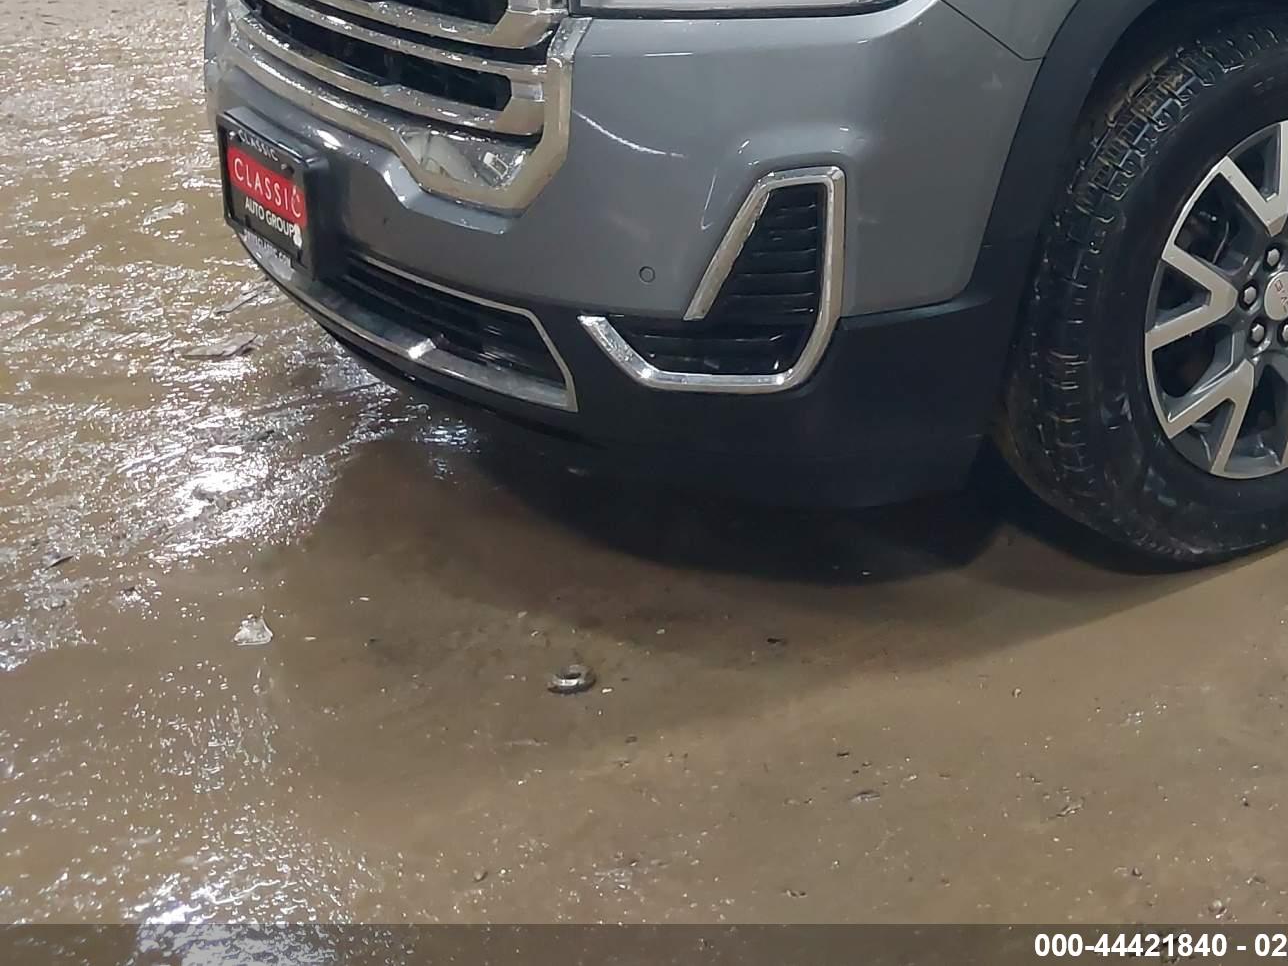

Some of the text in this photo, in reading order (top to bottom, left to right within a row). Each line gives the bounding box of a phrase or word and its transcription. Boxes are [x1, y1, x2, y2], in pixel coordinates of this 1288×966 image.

[238, 129, 279, 162] CLASSIC
[234, 157, 302, 218] CLASSIC
[244, 196, 296, 236] AUTO GROUP
